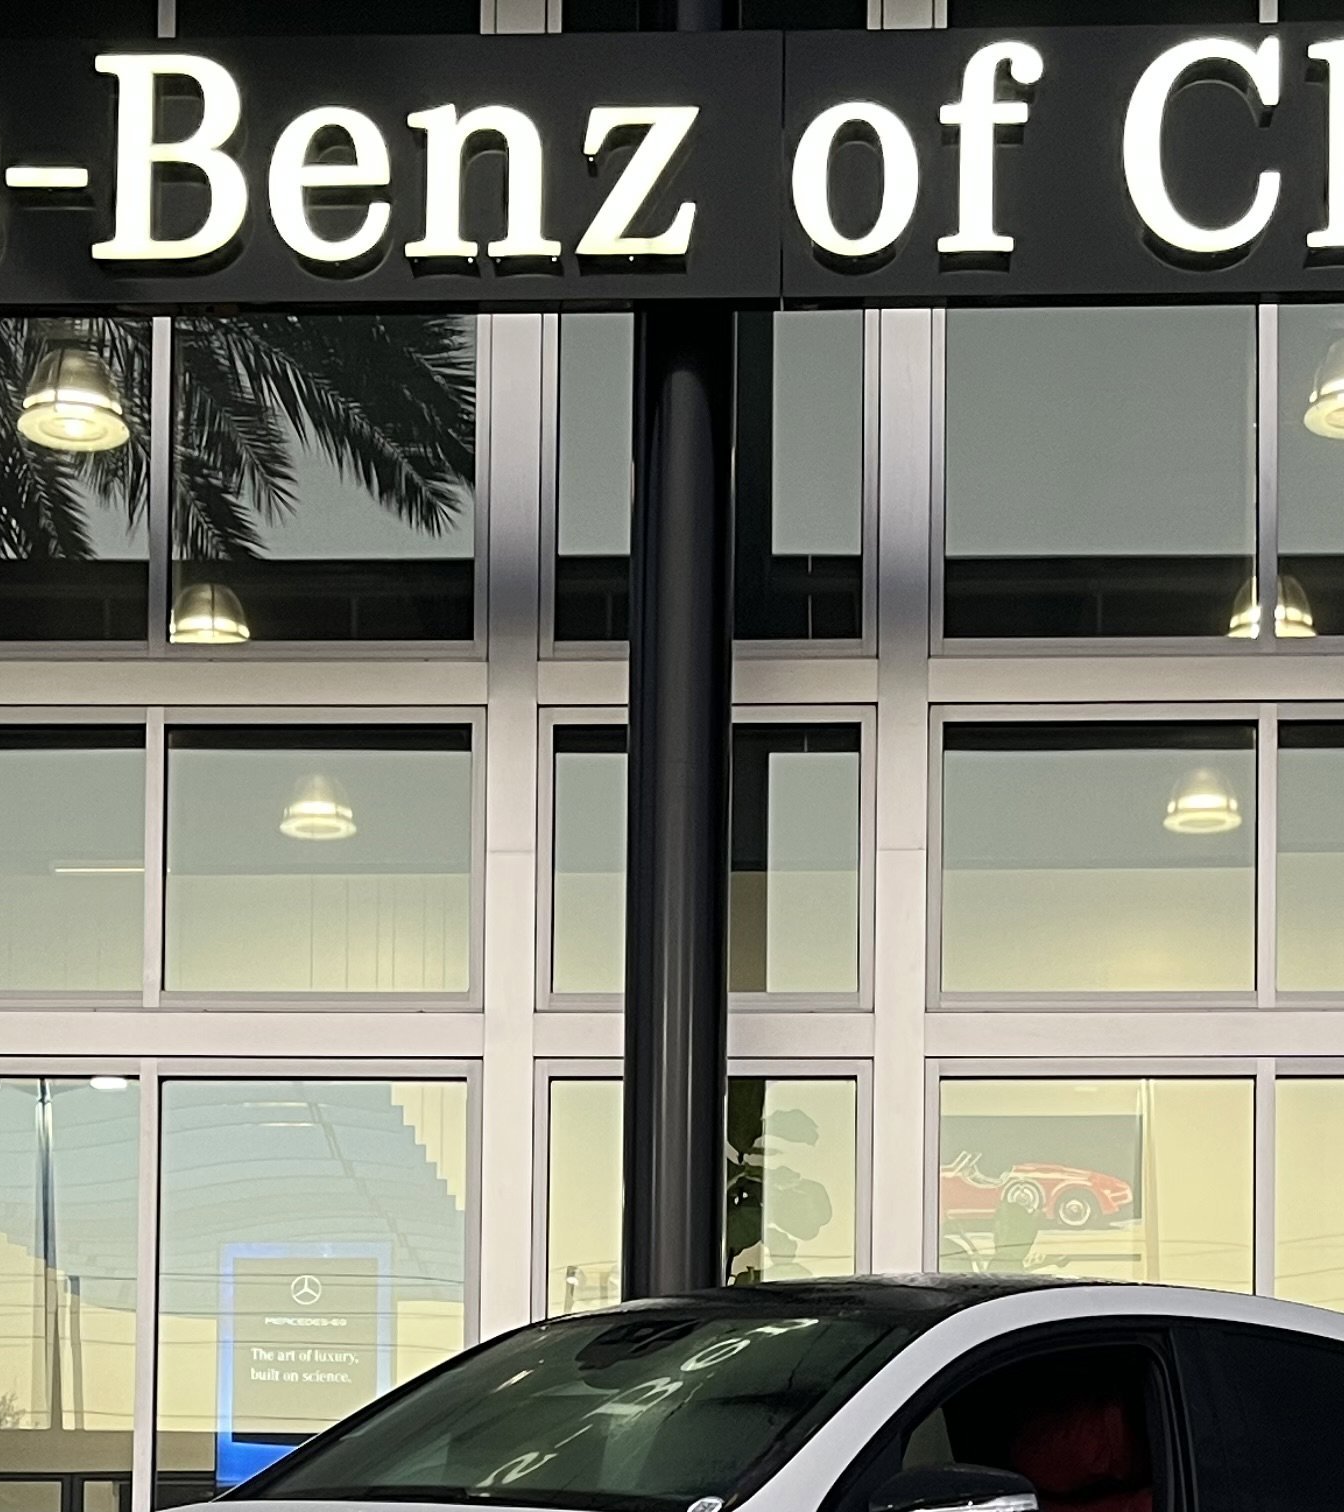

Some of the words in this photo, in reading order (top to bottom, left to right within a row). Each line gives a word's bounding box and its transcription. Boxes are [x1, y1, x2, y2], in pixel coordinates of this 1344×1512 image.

[792, 41, 1044, 256] of
[250, 1347, 274, 1361] The
[277, 1350, 296, 1362] art
[298, 1349, 313, 1362] of
[314, 1349, 360, 1366] luxury,
[250, 1368, 280, 1381] built
[282, 1371, 299, 1382] on
